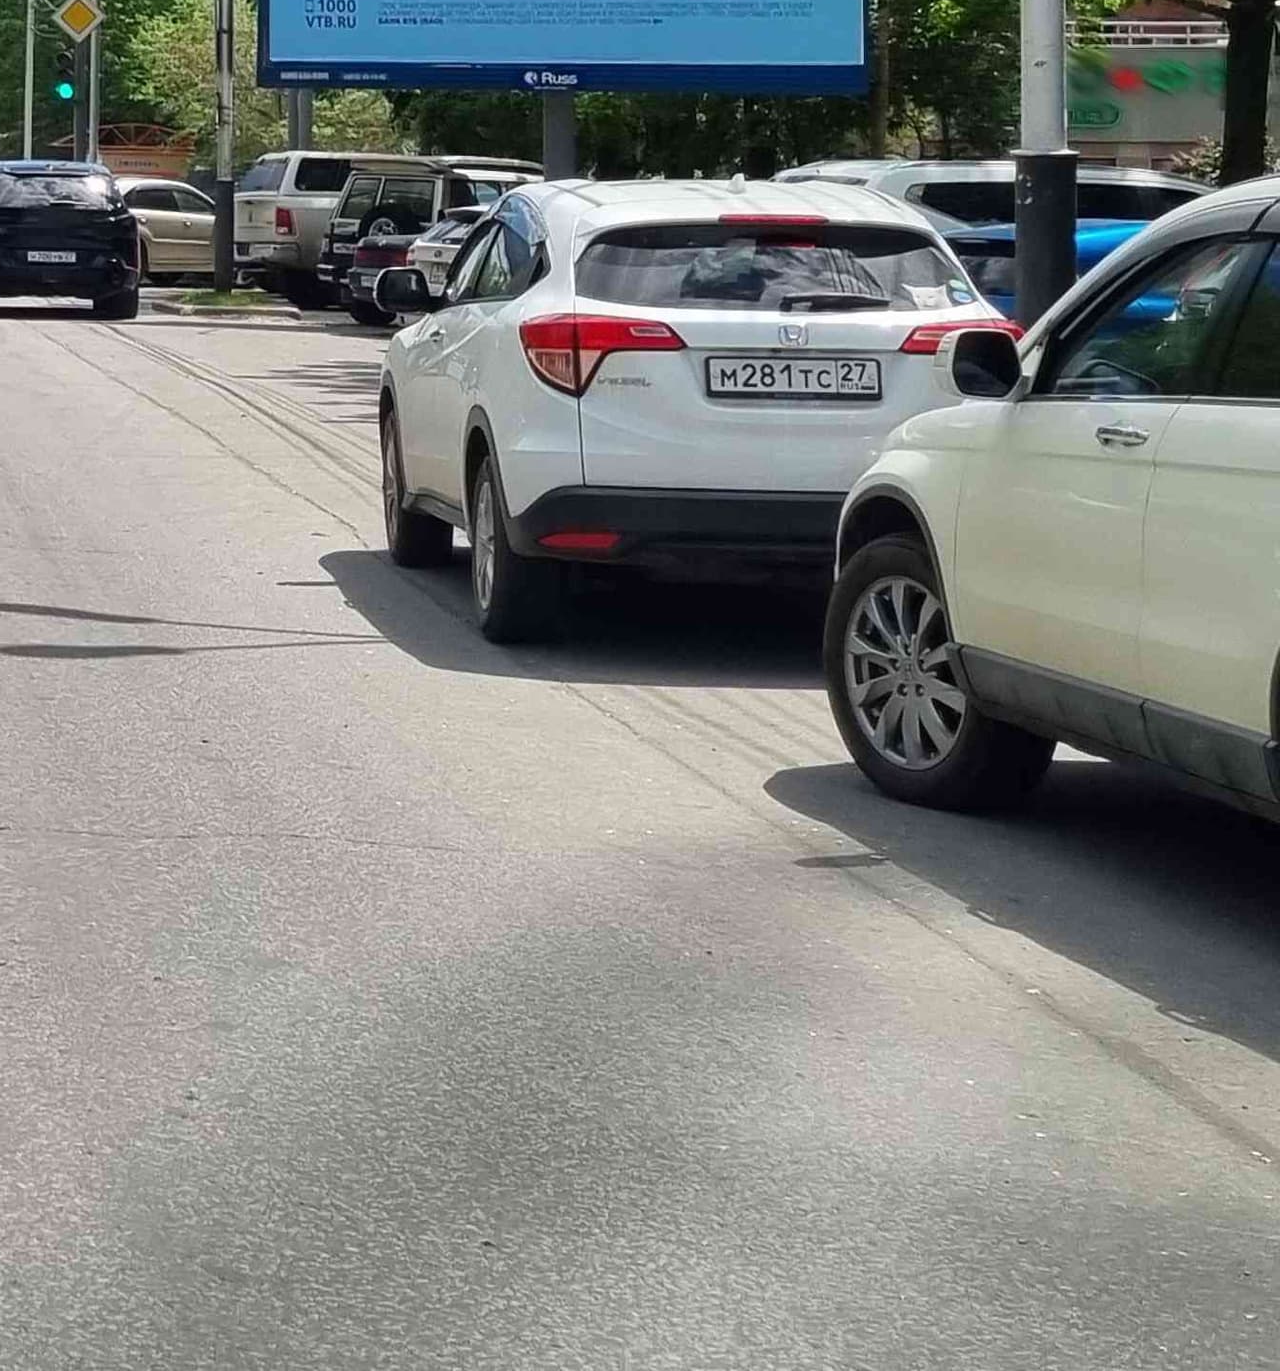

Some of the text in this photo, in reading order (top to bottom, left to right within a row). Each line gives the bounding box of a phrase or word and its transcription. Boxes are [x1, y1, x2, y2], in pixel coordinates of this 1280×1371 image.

[305, 15, 357, 29] VTB.RU
[541, 72, 579, 85] Russ
[720, 363, 866, 389] М281ТС 27
